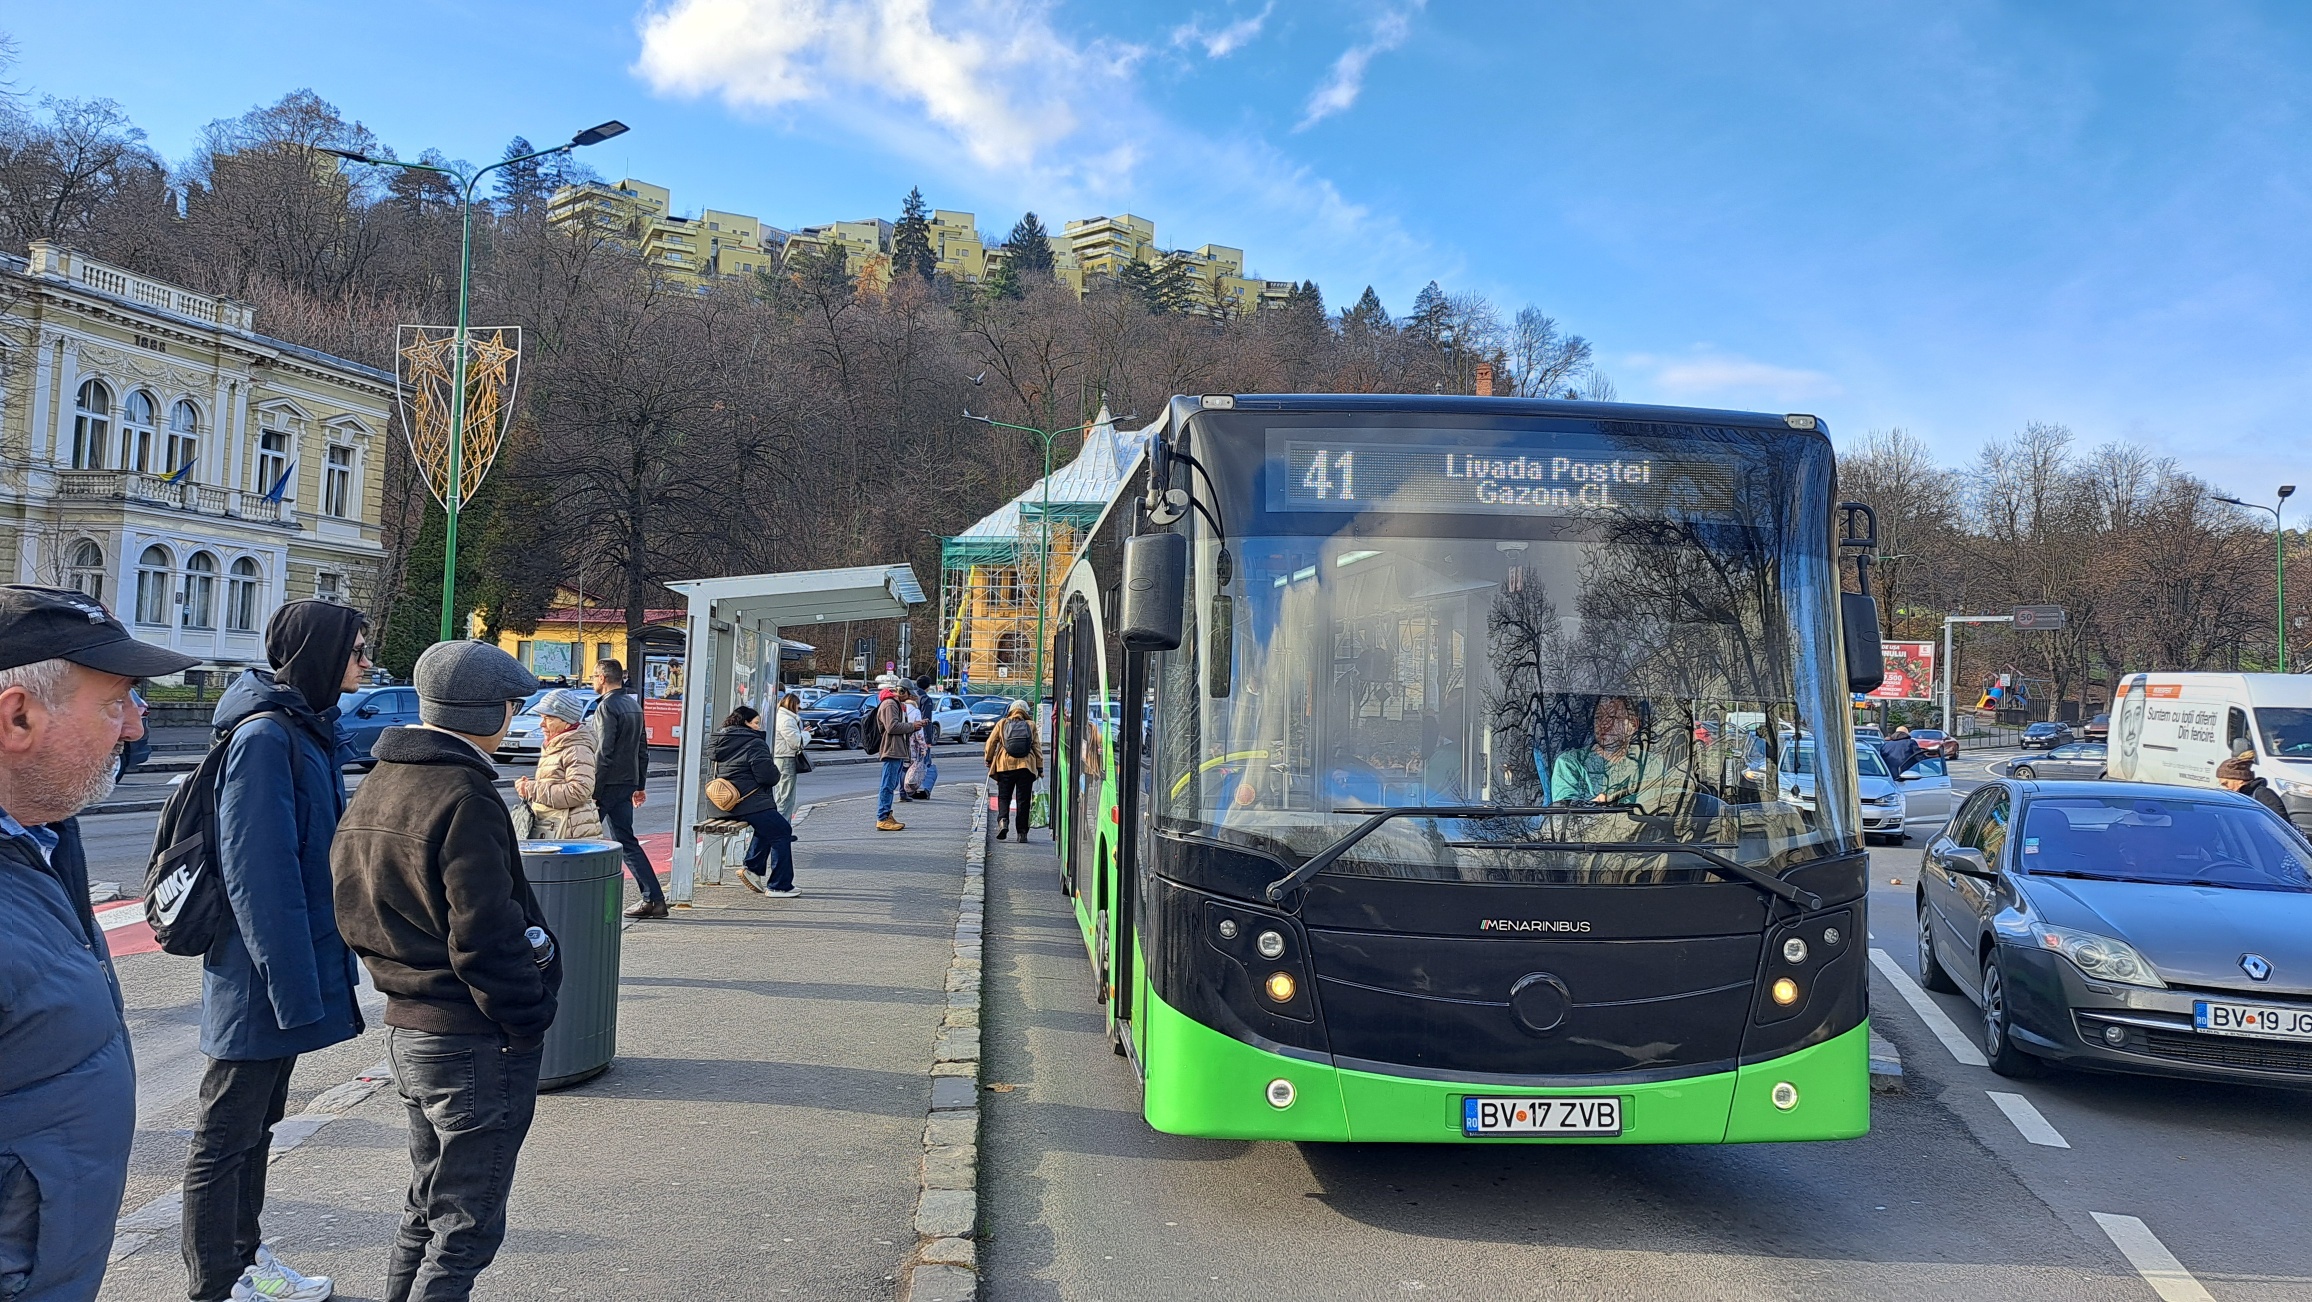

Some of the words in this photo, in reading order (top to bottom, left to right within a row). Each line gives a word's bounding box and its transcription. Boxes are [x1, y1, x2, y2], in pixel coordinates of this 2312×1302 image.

[134, 335, 166, 353] 1888
[1303, 450, 1354, 500] 41
[1446, 453, 1542, 480] Livada
[1552, 457, 1650, 483] Postei
[1476, 480, 1569, 506] Gazon
[2020, 613, 2032, 621] 50
[2148, 707, 2170, 721] Suntem
[2172, 712, 2180, 722] cu
[2178, 725, 2189, 739] Din
[155, 863, 192, 911] NIKE
[1486, 919, 1591, 932] MENARINIBUS
[2196, 1016, 2206, 1025] RO
[2213, 1006, 2247, 1029] BV
[2257, 1010, 2280, 1031] 19
[1466, 1118, 1478, 1128] RO
[1481, 1102, 1517, 1128] BV
[1528, 1102, 1552, 1128] 17
[1559, 1102, 1615, 1128] ZVB
